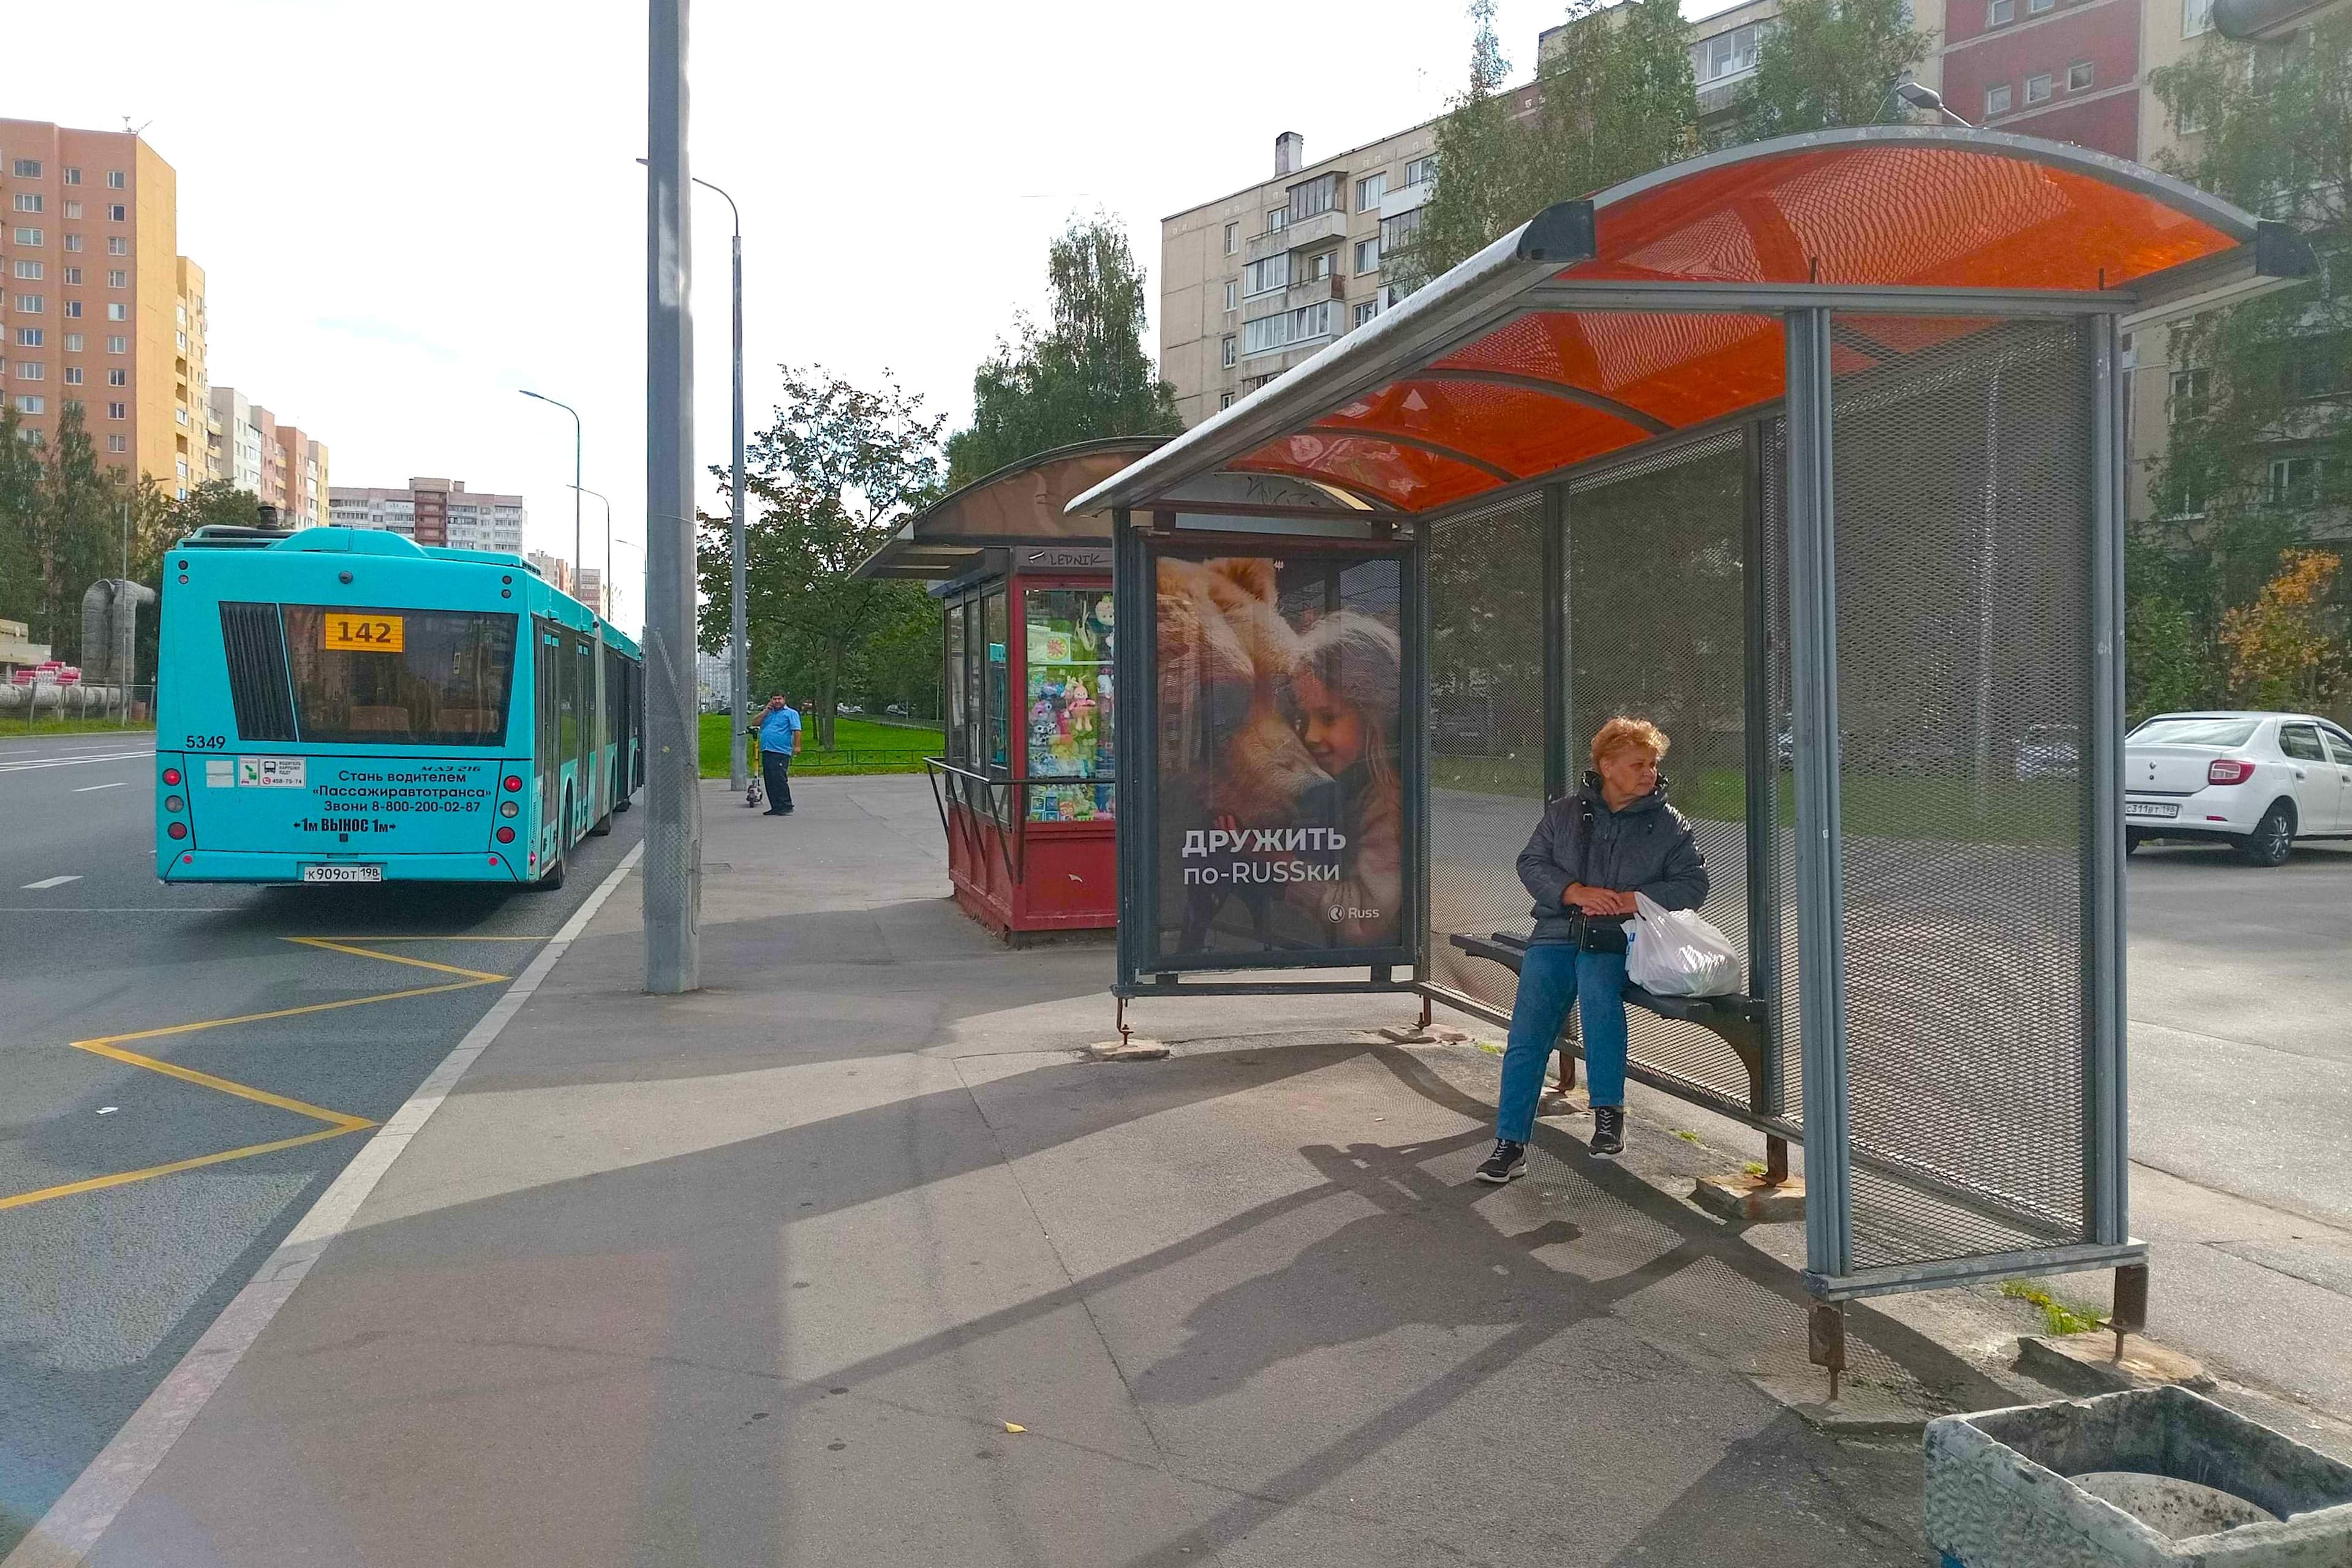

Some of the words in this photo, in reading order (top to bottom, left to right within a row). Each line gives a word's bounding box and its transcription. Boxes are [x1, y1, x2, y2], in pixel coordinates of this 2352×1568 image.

[337, 622, 391, 644] 142
[186, 735, 226, 749] 5349
[339, 770, 383, 782] Стань
[387, 772, 467, 783] водителем
[312, 785, 492, 799] «Пассажиравтотранса»
[324, 800, 368, 812] Звони
[371, 801, 481, 812] 8-800-200-02-87
[321, 818, 369, 832] ВЫНОС
[1182, 827, 1347, 858] ДРУЖИТЬ
[360, 868, 379, 877] 198
[1183, 860, 1340, 885] по-RUSSки
[1348, 907, 1380, 919] Russ
